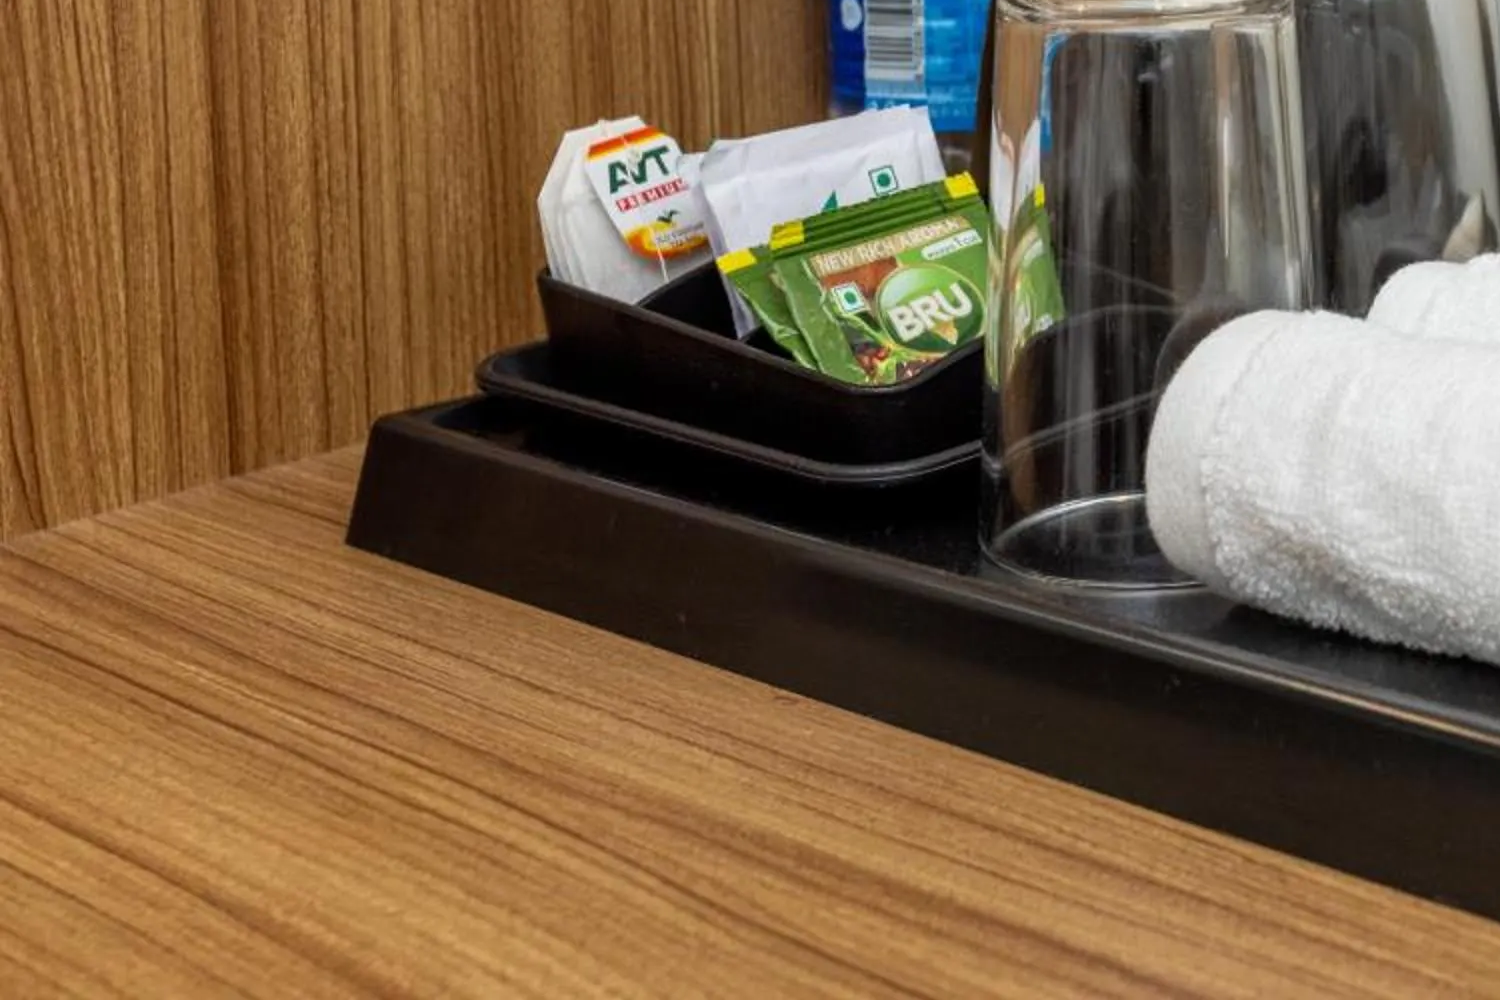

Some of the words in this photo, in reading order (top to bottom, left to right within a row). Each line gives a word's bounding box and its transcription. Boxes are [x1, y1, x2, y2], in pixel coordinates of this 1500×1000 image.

[608, 145, 669, 194] AVT
[815, 250, 853, 275] NEW
[857, 237, 894, 263] RICH
[898, 217, 962, 251] AROMA
[887, 282, 973, 343] BRU
